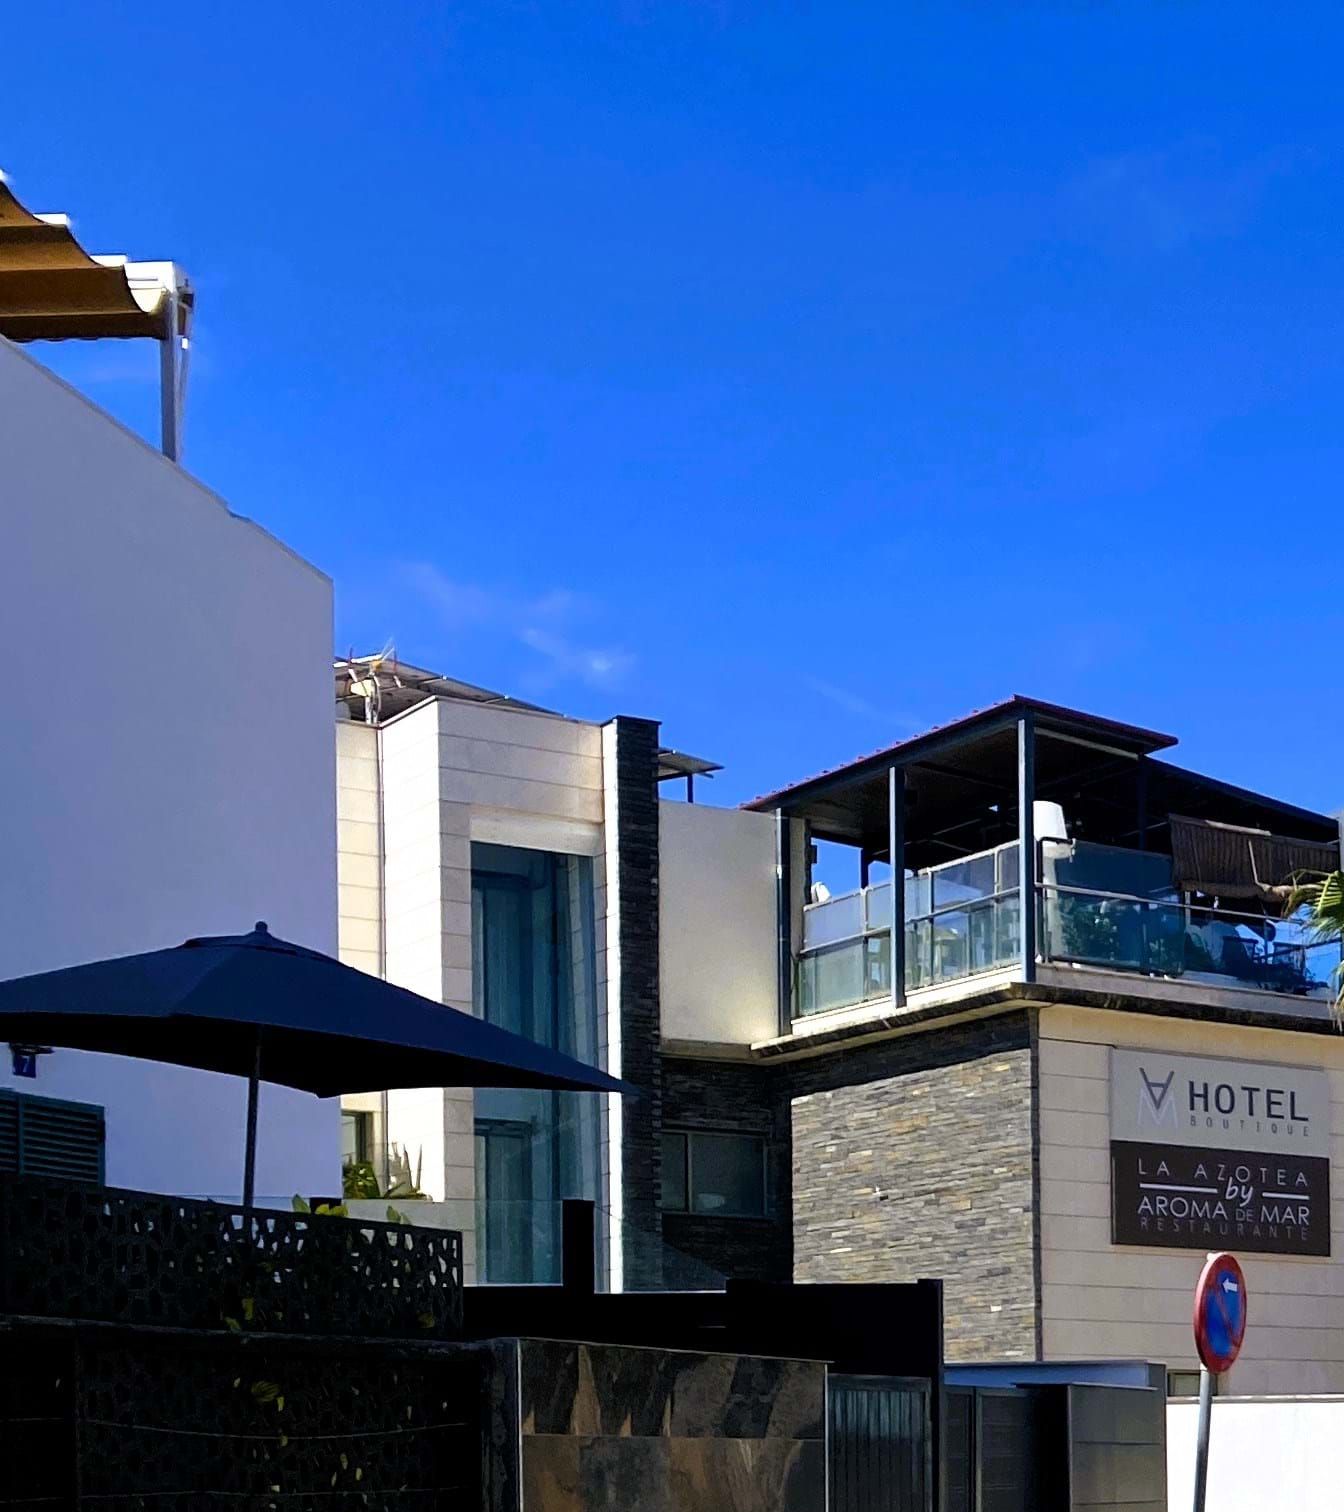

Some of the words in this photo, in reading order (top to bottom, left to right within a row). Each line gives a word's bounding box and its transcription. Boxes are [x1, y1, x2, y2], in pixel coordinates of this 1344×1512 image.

[1188, 1080, 1310, 1122] HOTEL
[1190, 1115, 1310, 1137] BOUTIQUE
[1138, 1157, 1171, 1176] LA
[1193, 1163, 1309, 1188] AZOTEA
[1224, 1175, 1254, 1208] by
[1137, 1195, 1229, 1221] AROMA
[1235, 1207, 1254, 1222] DE
[1260, 1204, 1311, 1226] MAR
[1140, 1216, 1310, 1241] RESTAURANTE
